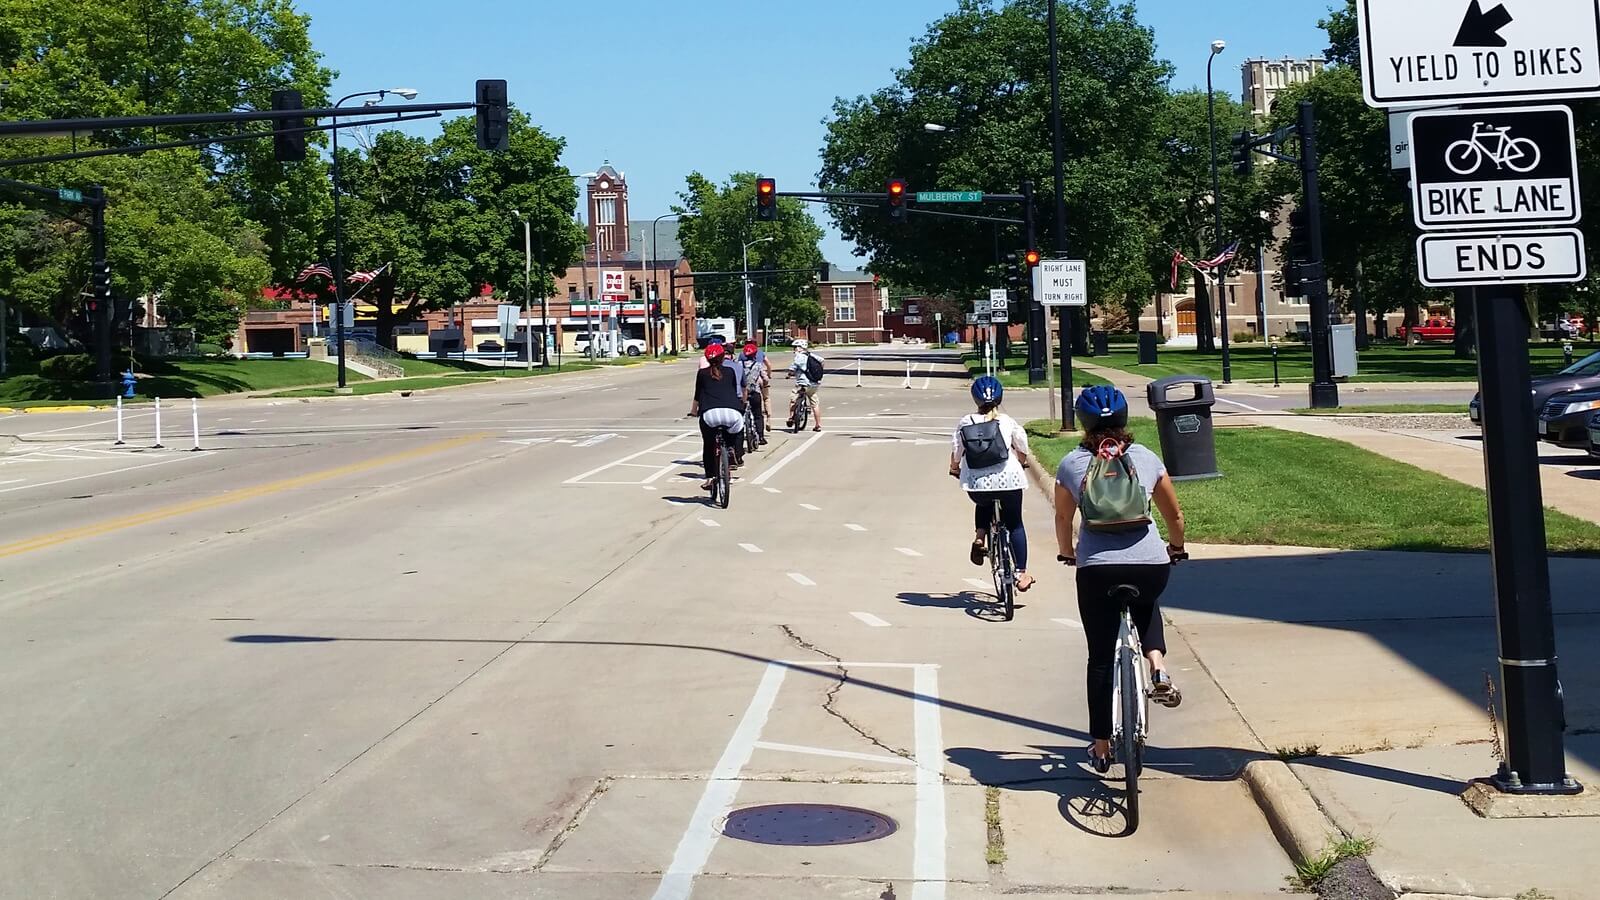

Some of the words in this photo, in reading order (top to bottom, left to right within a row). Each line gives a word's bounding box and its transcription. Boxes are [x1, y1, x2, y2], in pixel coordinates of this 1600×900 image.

[1389, 53, 1458, 83] YIELD
[1472, 51, 1500, 79] TO
[1514, 46, 1583, 77] BIKES
[1394, 140, 1409, 155] gir
[919, 192, 963, 201] MULBERRY
[967, 192, 978, 201] ST
[1428, 187, 1486, 216] BIKE
[1496, 184, 1566, 213] LANE
[1455, 242, 1546, 272] ENDS
[1044, 264, 1063, 272] RIGHT
[1065, 264, 1081, 272] LANE
[1053, 278, 1073, 287] MUST
[1044, 292, 1061, 301] TURN
[1064, 292, 1083, 301] RIGHT
[992, 299, 1006, 308] 20
